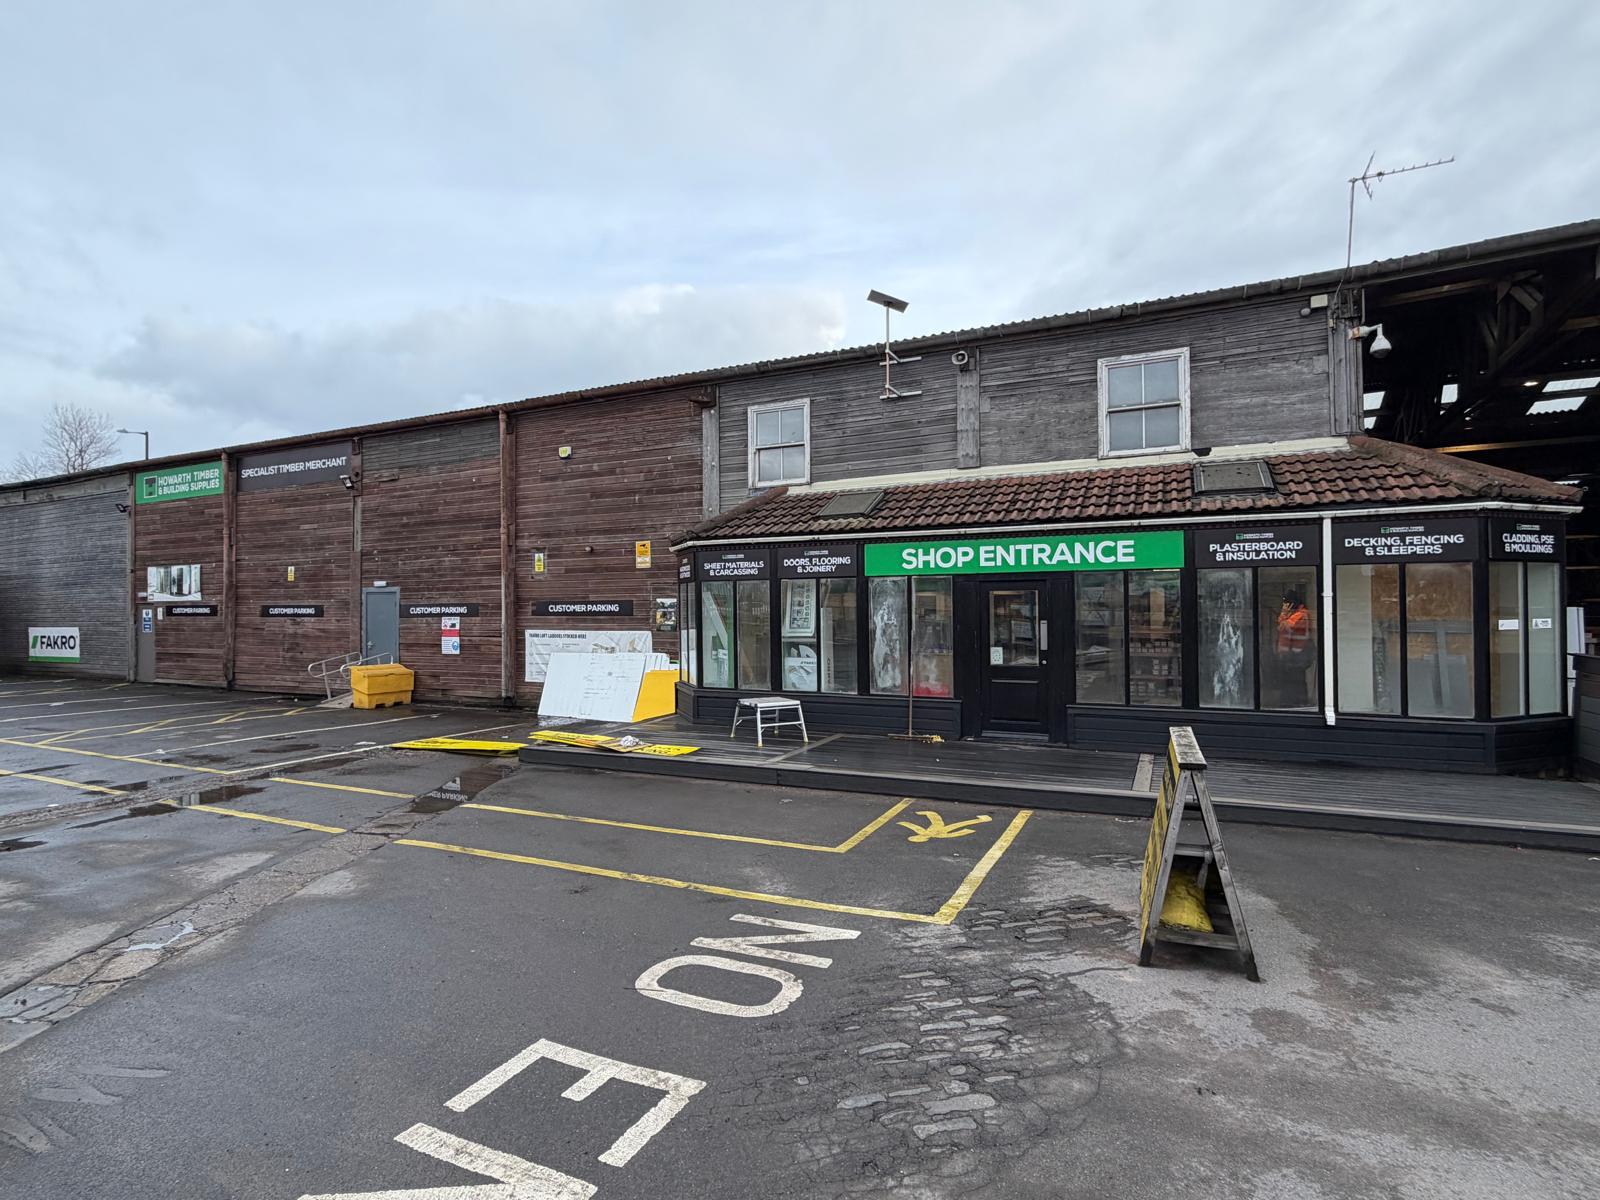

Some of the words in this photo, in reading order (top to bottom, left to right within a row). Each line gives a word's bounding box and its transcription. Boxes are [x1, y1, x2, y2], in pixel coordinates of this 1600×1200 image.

[241, 465, 279, 478] SPECIALIST
[279, 462, 305, 475] TIMBER
[305, 456, 347, 471] MERCHANT
[158, 474, 192, 487] HOWARTH
[193, 468, 219, 482] TIMBER
[158, 487, 163, 495] &
[163, 483, 189, 495] BUILDING
[190, 479, 220, 491] SUPPLIES
[1345, 537, 1404, 548] DECKING,
[1405, 534, 1465, 545] FENCING
[1502, 534, 1539, 544] CLADDING,
[1540, 535, 1554, 544] PSE
[1209, 541, 1303, 552] PLASTERBOARD
[1365, 547, 1374, 556] &
[1376, 545, 1443, 555] SLEEPERS
[1505, 544, 1510, 552] &
[1511, 544, 1553, 554] MOULDINGS
[902, 547, 974, 570] SHOP
[979, 540, 1135, 567] ENTRANCE
[1216, 553, 1224, 561] &
[1225, 551, 1296, 561] INSULATION
[704, 562, 725, 570] SHEET
[725, 561, 764, 569] MATERIALS
[784, 558, 811, 567] DOORS,
[811, 557, 851, 565] FLOORING
[715, 568, 758, 576] CARCASSING
[803, 565, 836, 573] JOINERY
[441, 606, 467, 614] PARKING
[548, 605, 587, 613] CUSTOMER
[587, 604, 620, 612] PARKING
[40, 635, 77, 650] FAKRO
[634, 913, 861, 1018] NO
